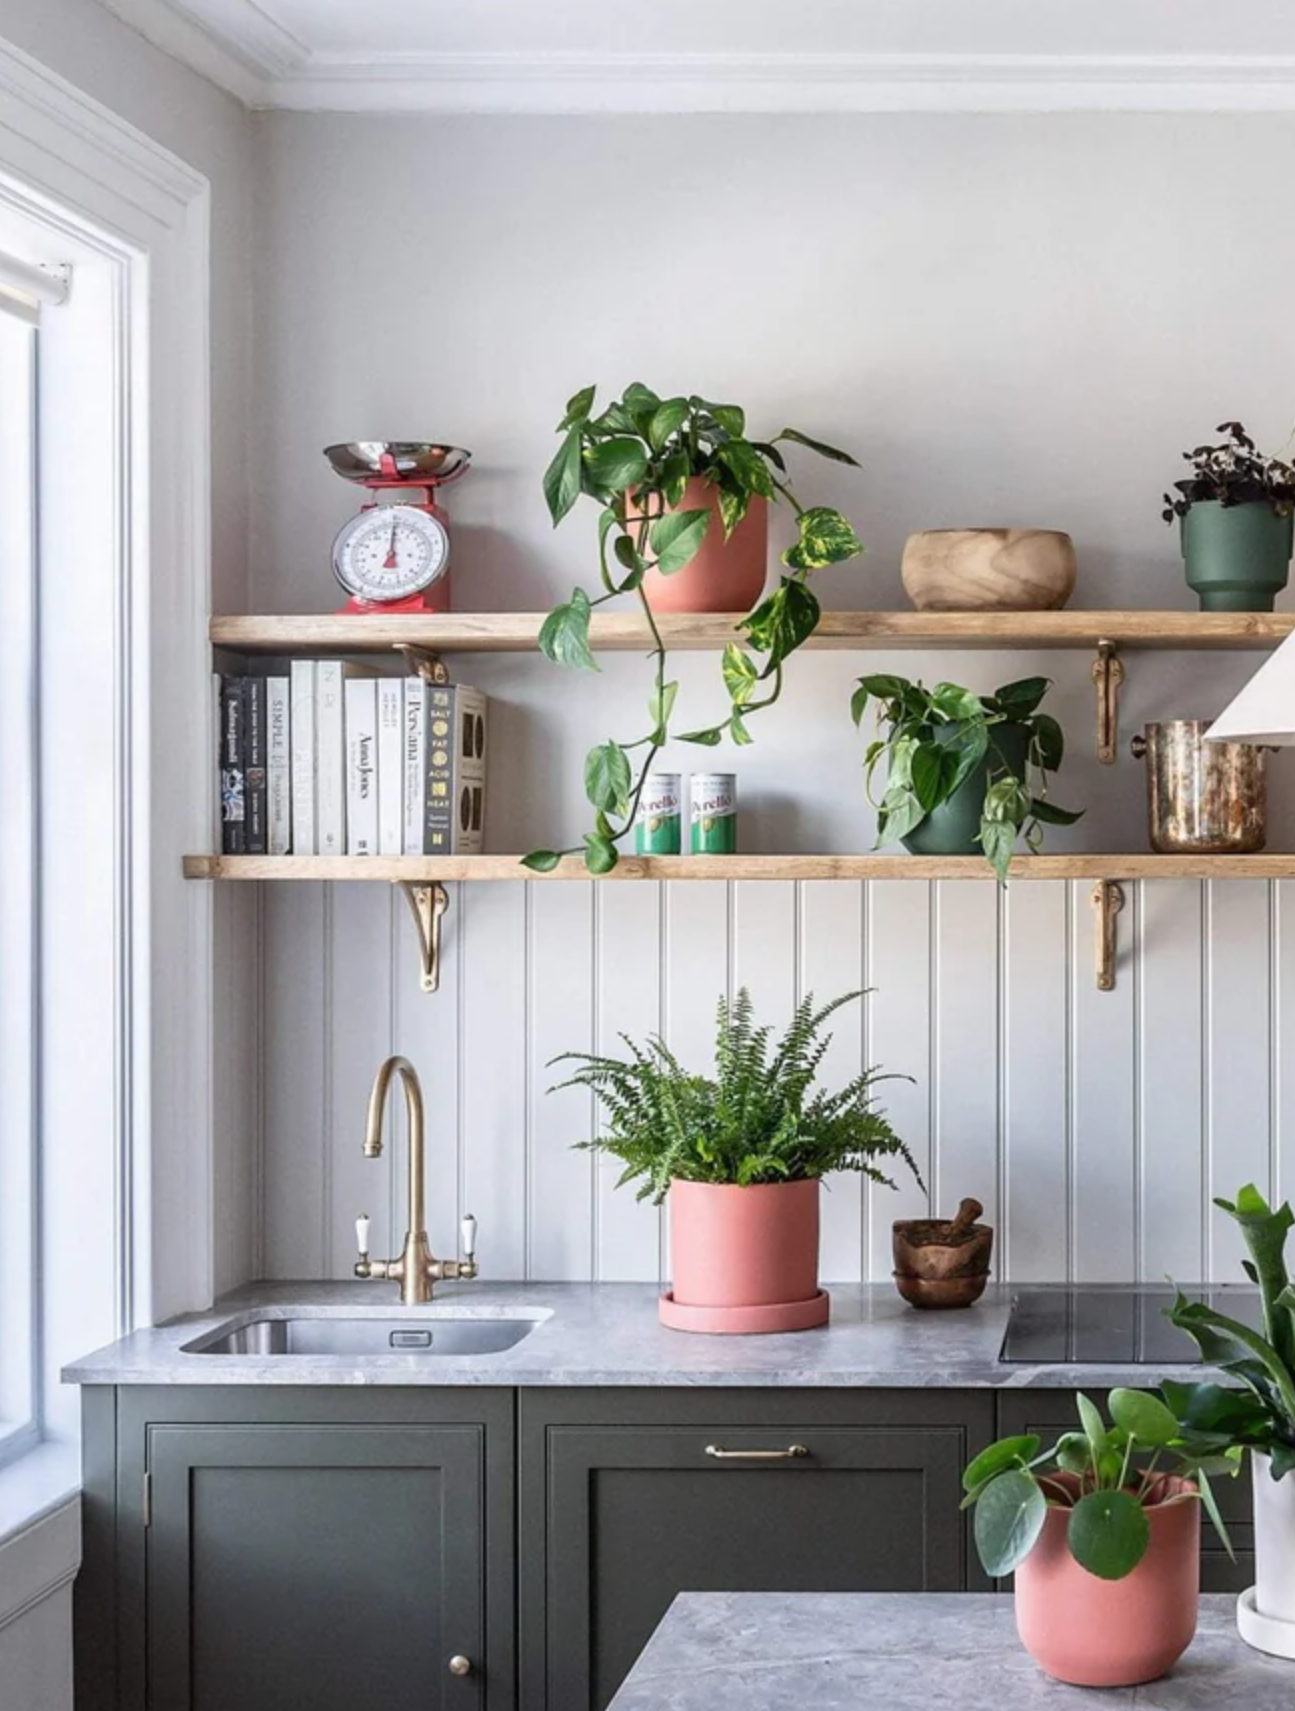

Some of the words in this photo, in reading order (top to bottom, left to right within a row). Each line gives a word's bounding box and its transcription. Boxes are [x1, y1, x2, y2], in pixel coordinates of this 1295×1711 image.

[272, 699, 283, 748] SIMPLE
[430, 710, 451, 718] SALT
[408, 701, 422, 761] Persiana
[359, 732, 372, 766] Anna
[356, 766, 374, 799] Jones
[428, 770, 450, 778] ACID
[427, 800, 450, 808] HEAT
